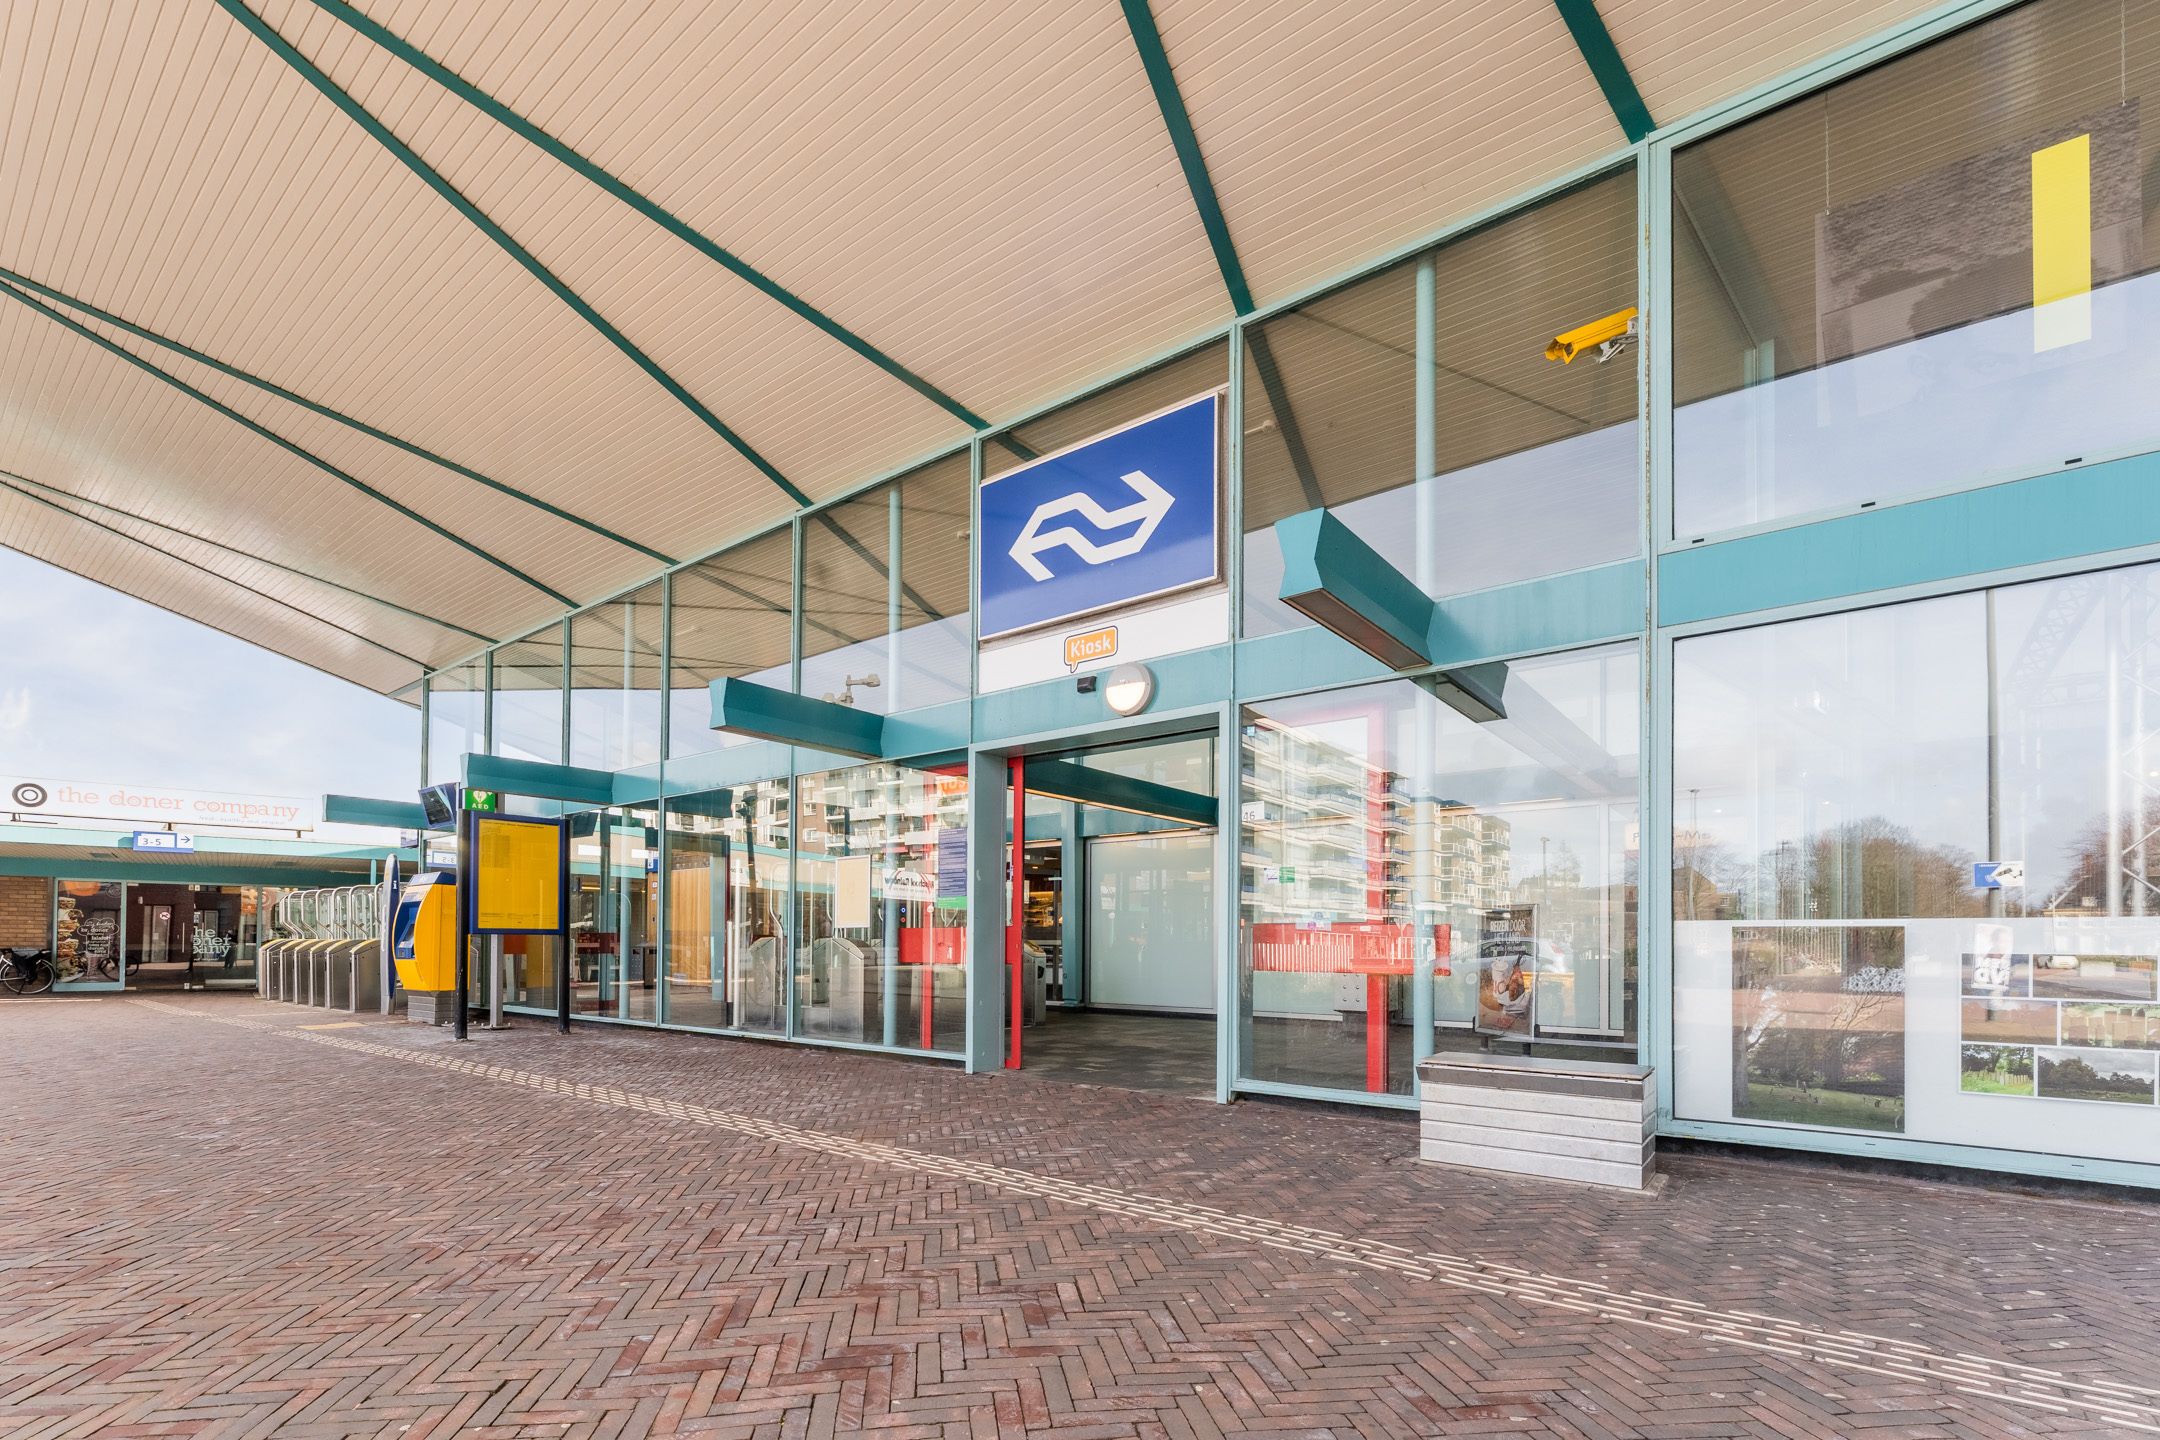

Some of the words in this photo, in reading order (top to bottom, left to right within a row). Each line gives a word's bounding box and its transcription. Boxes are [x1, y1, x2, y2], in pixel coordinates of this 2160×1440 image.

[1071, 634, 1112, 658] Kiosk
[57, 786, 99, 805] the
[108, 790, 184, 810] doner
[193, 800, 300, 821] company
[142, 838, 161, 846] 3-5
